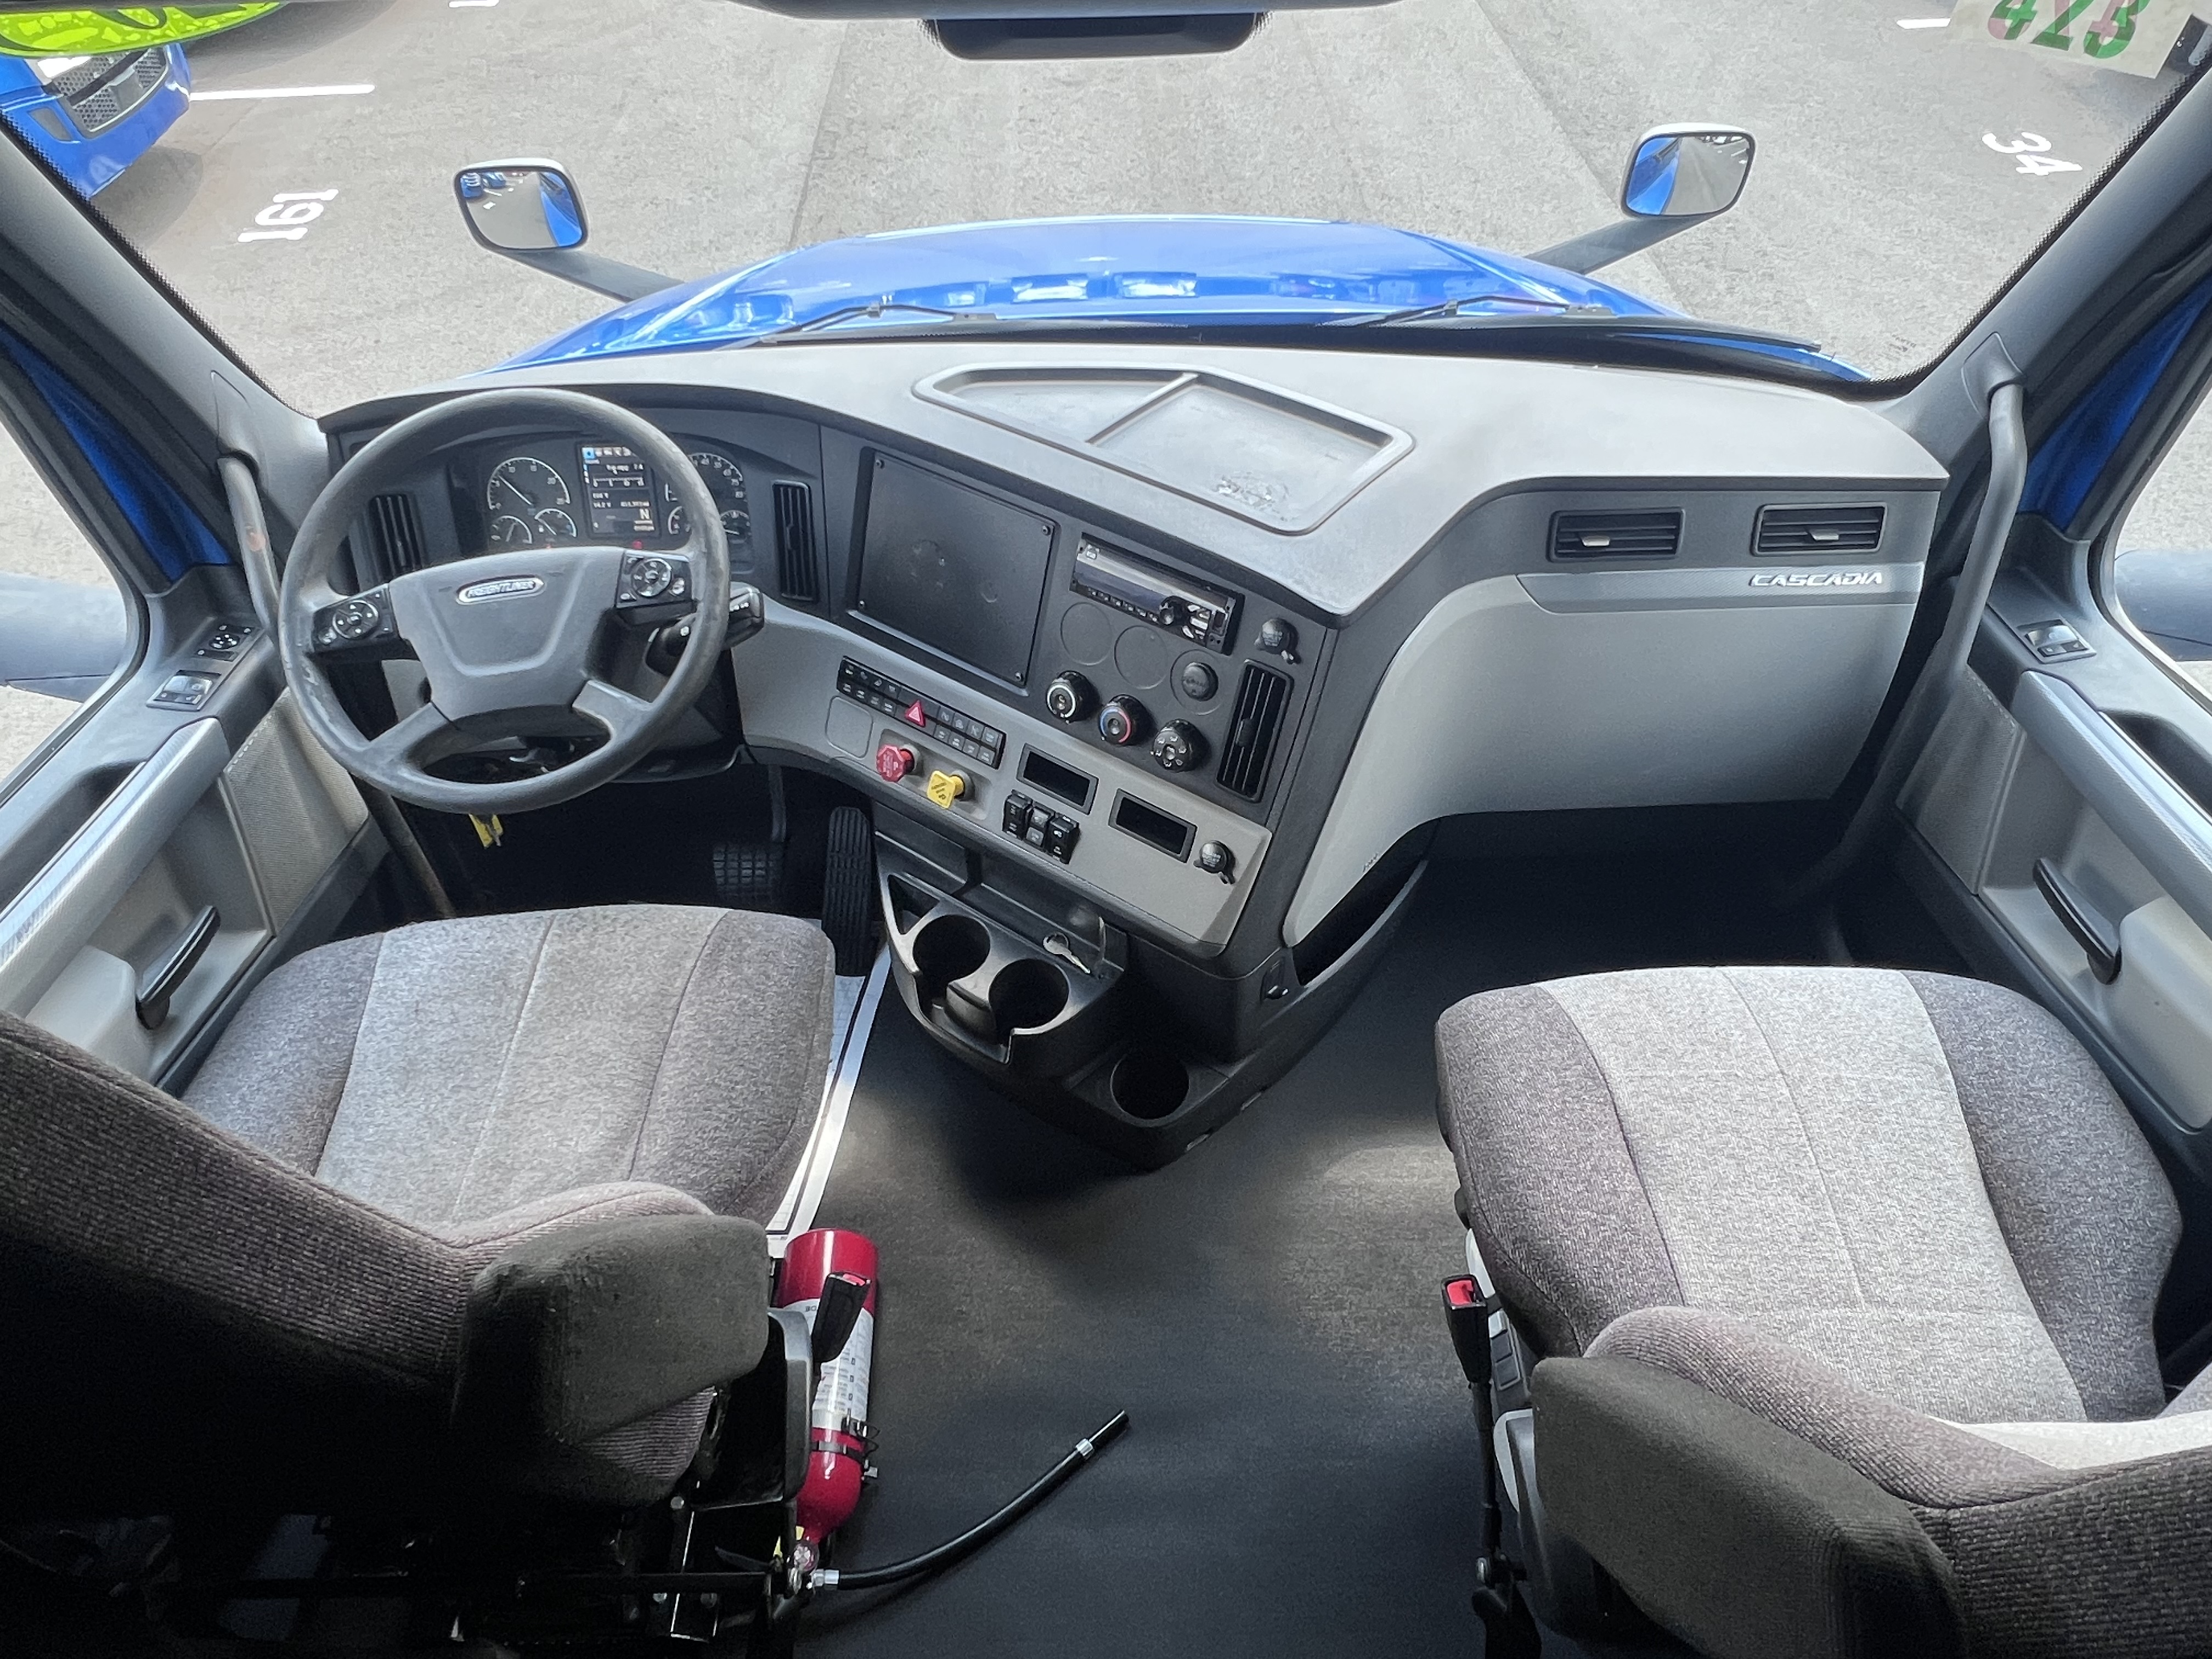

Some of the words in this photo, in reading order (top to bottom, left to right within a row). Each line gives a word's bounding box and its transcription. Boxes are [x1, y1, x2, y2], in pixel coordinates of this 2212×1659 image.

[1982, 132, 2083, 176] 34
[640, 508, 650, 520] N
[1750, 572, 1883, 586] CASCADIA
